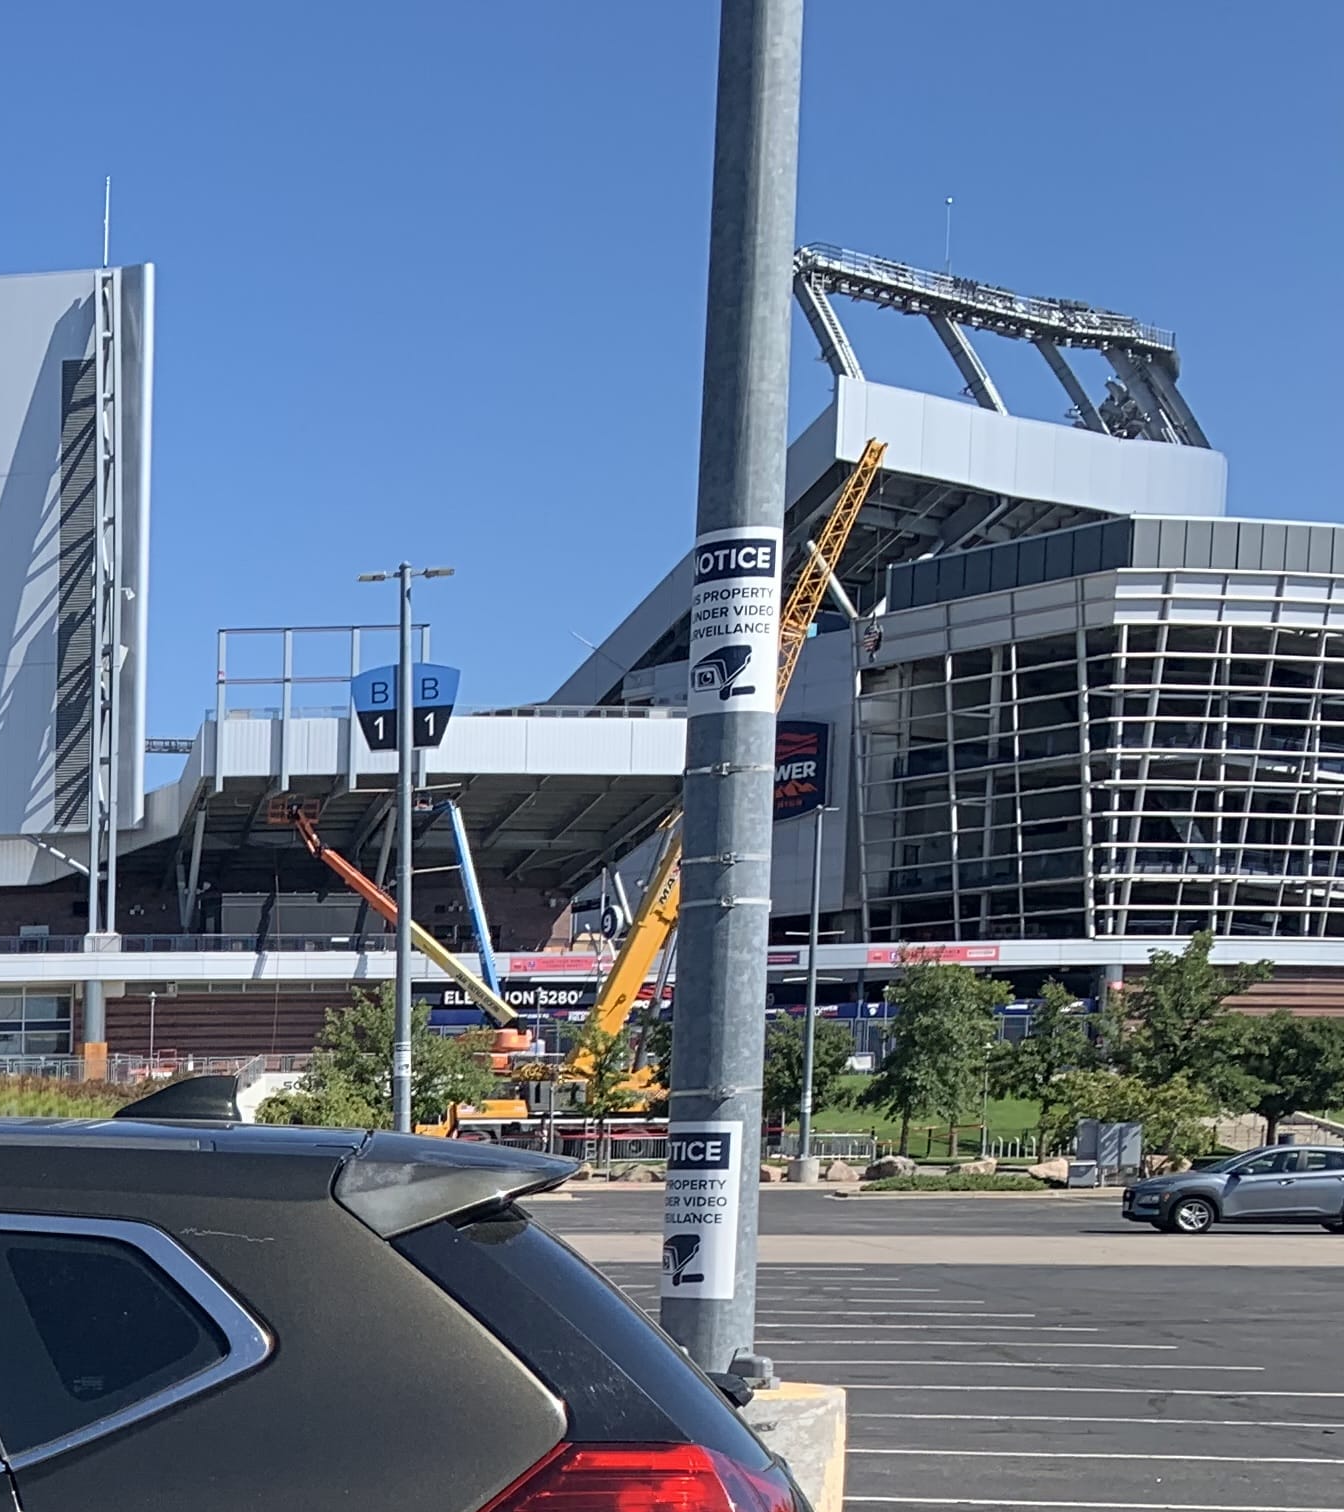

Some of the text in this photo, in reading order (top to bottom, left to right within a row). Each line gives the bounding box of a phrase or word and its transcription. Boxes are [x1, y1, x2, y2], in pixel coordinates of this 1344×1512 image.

[703, 587, 774, 604] PROPERTY
[693, 605, 774, 624] NDER VIDEO
[692, 623, 771, 641] RVEILLANCE
[371, 681, 389, 704] B
[421, 677, 439, 700] B
[374, 716, 384, 740] 1
[424, 712, 434, 736] 1
[603, 915, 612, 932] 9
[444, 990, 534, 1006] ELEION
[667, 1140, 722, 1161] TICE
[683, 1196, 727, 1207] VIDEO
